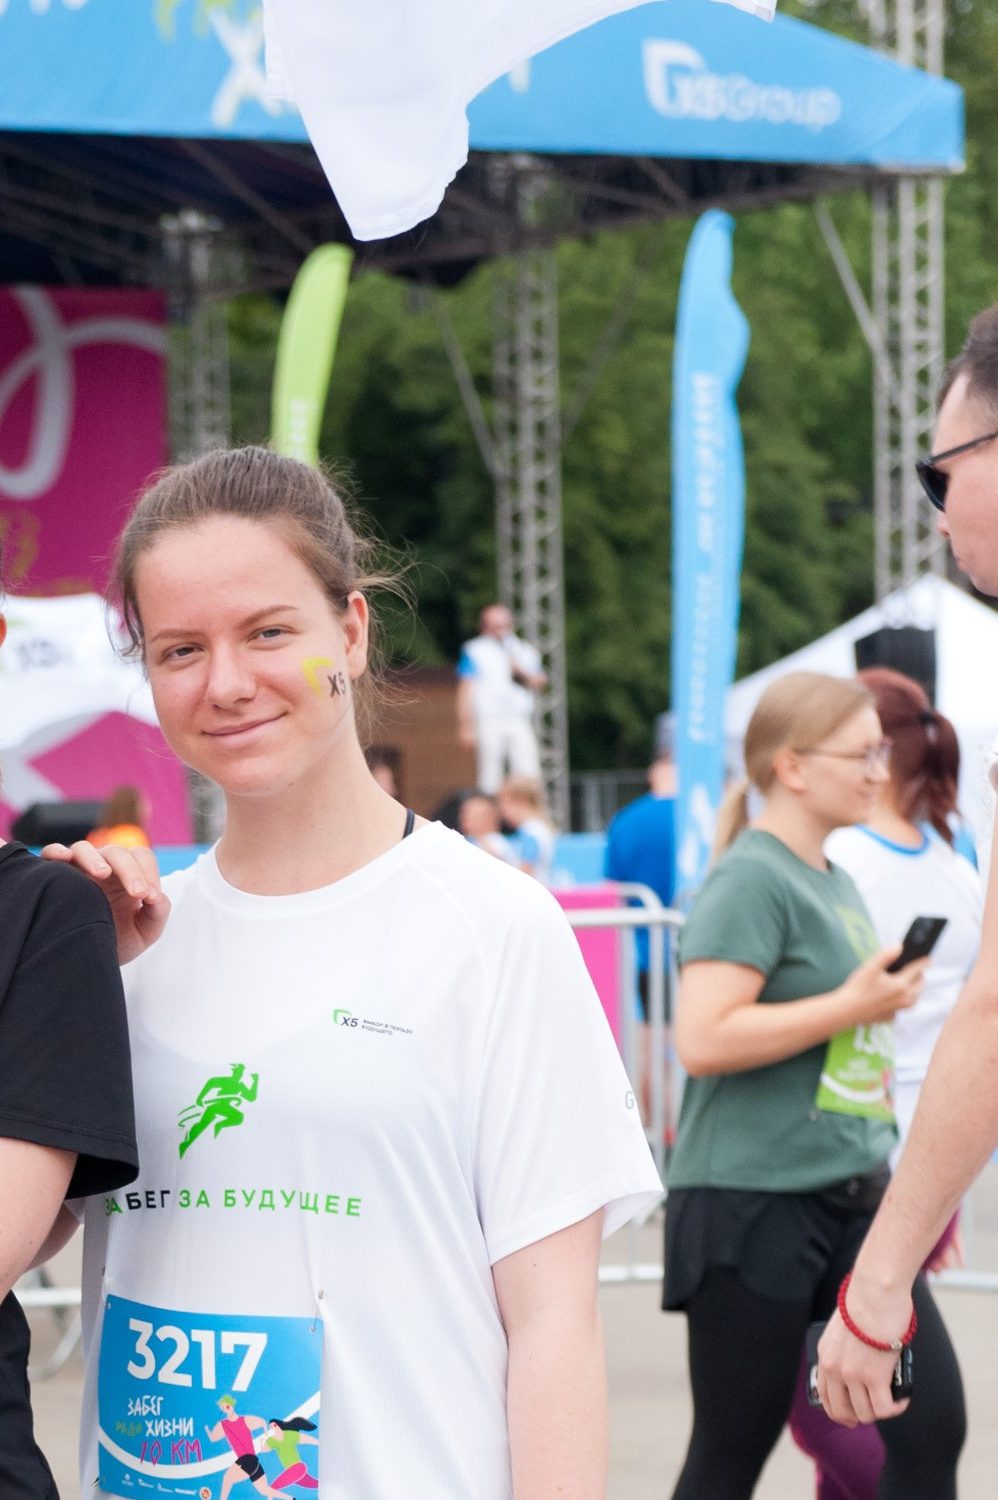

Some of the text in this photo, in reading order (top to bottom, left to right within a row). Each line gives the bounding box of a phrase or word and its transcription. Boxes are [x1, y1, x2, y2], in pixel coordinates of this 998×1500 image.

[327, 671, 347, 698] X5
[341, 1016, 359, 1028] X5
[178, 1189, 211, 1209] ЗА
[223, 1189, 362, 1217] БУДУЩЕЕ
[127, 1317, 268, 1392] 3217
[127, 1394, 164, 1416] ЗАБЕГ
[140, 1437, 202, 1467] 10 КМ
